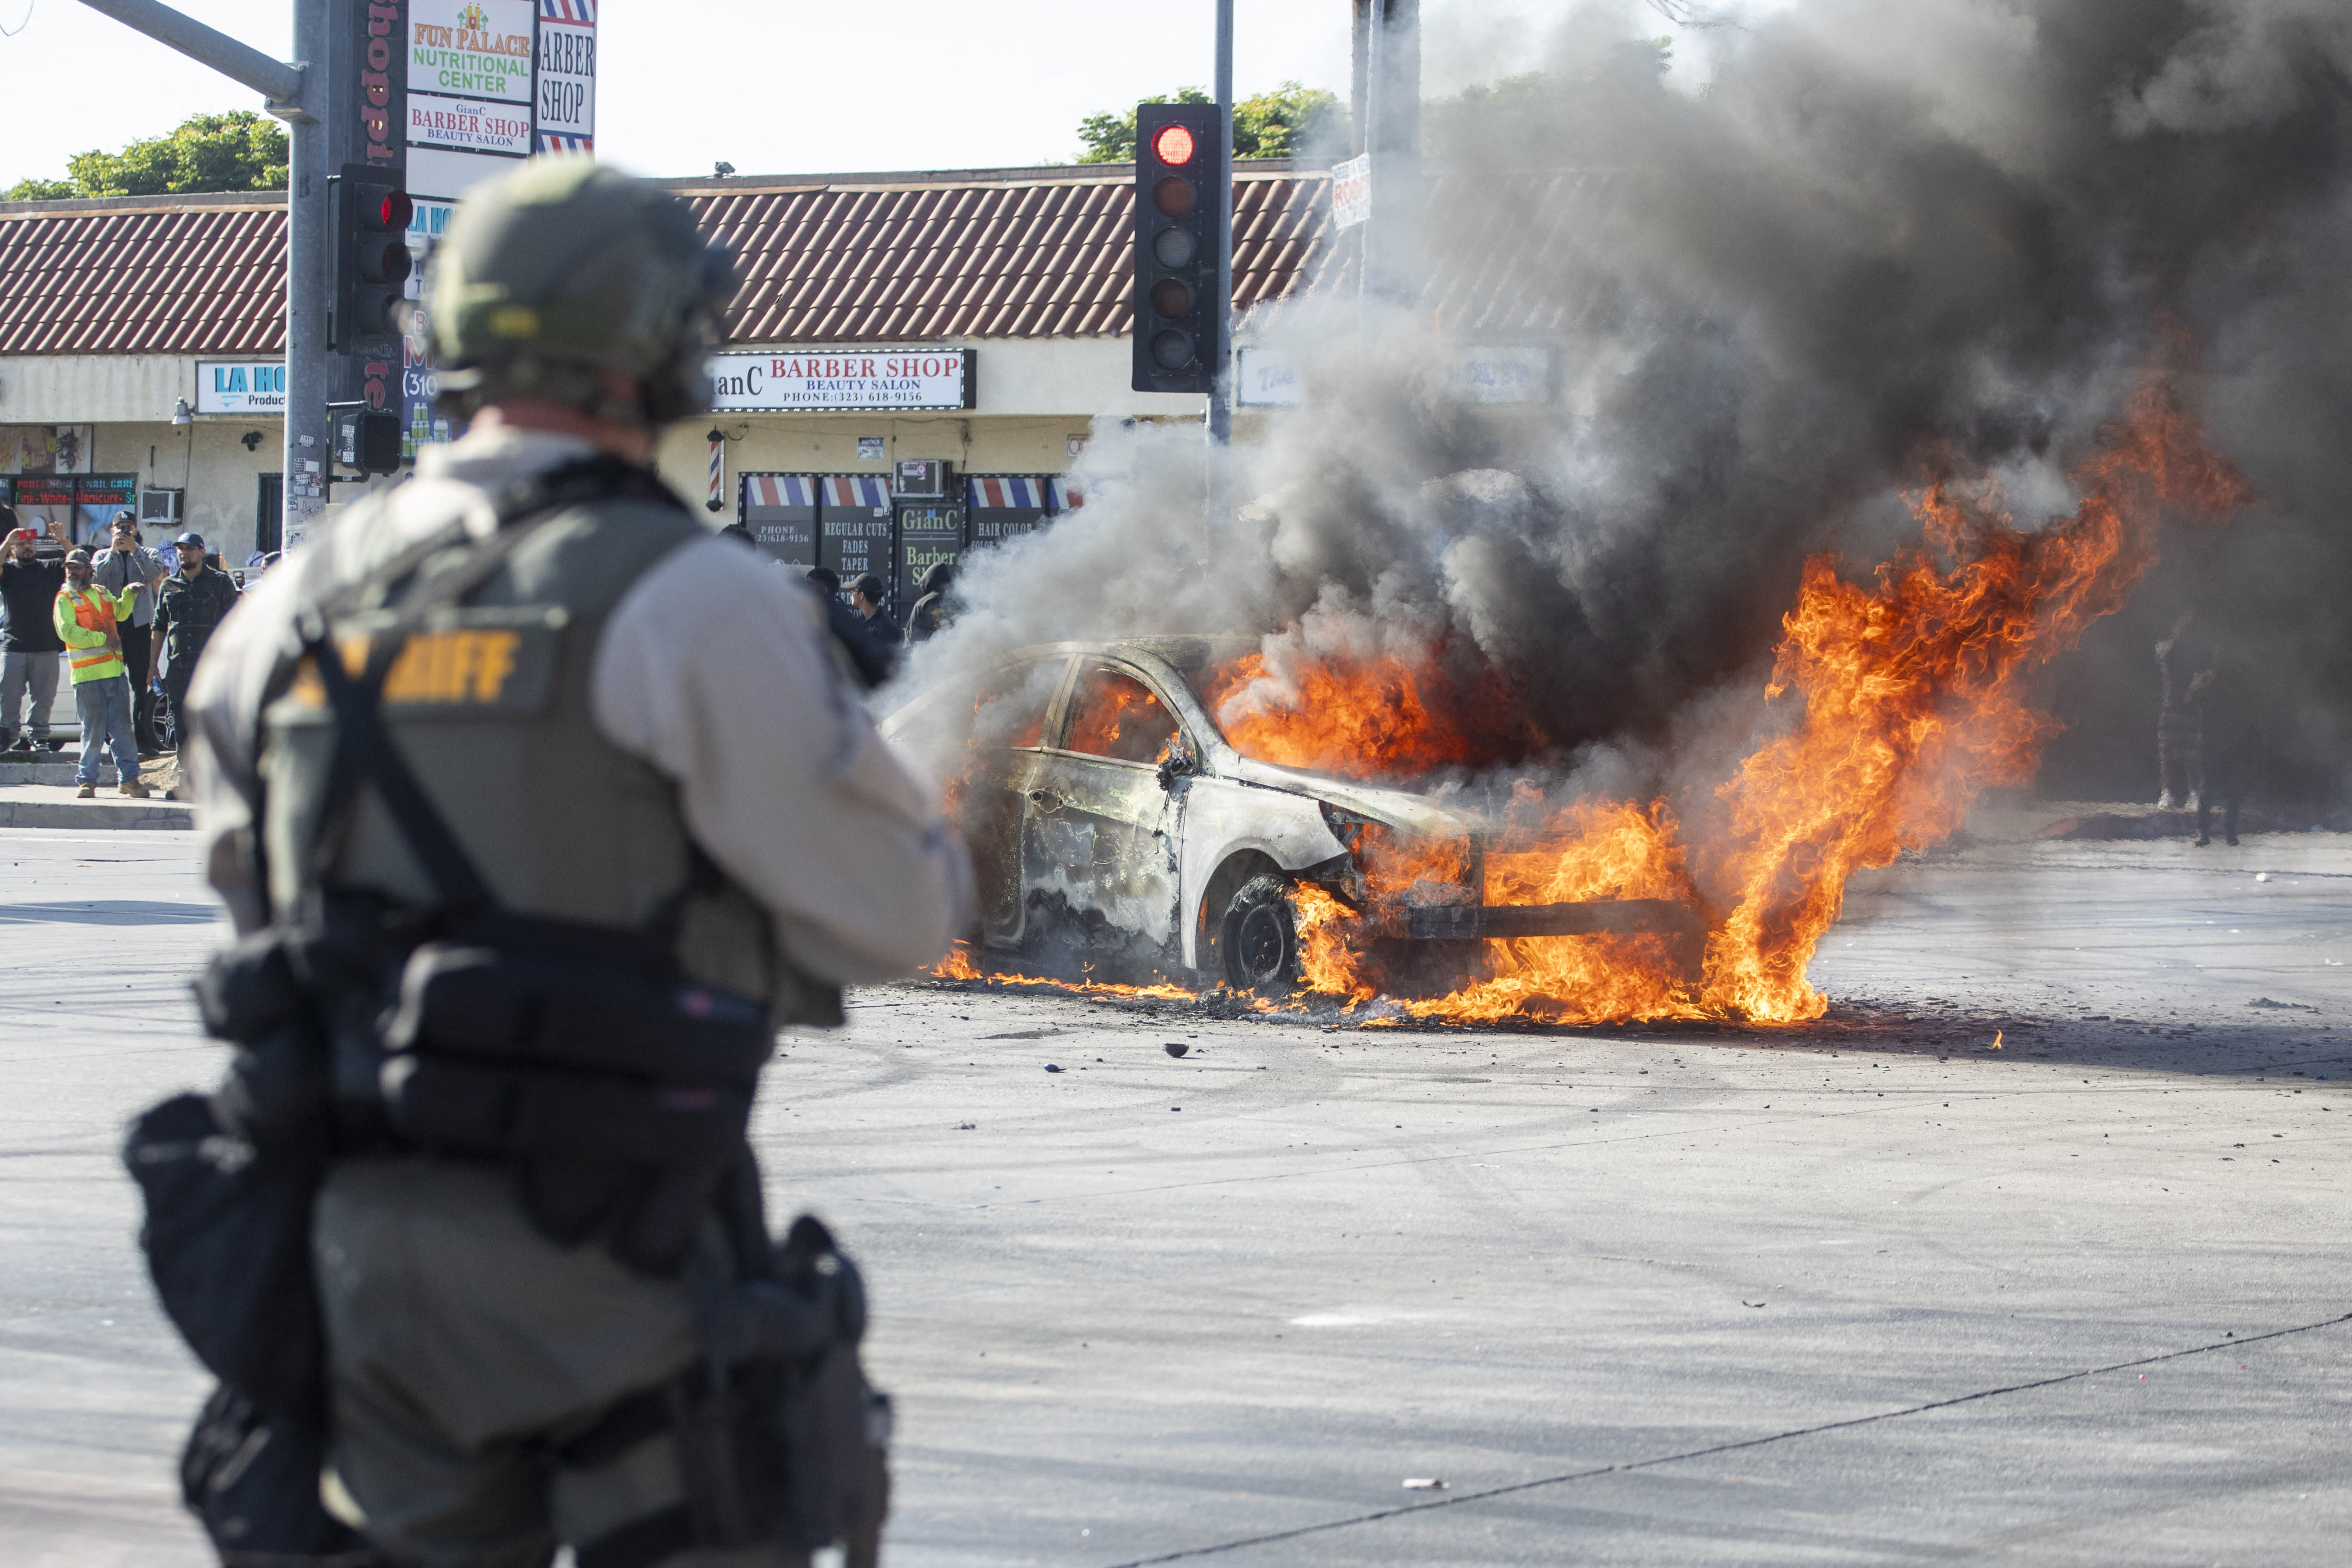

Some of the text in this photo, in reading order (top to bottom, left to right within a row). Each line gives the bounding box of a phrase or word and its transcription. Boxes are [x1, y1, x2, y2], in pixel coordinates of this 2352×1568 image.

[414, 23, 530, 58] FUN PALACE
[414, 47, 529, 77] NUTRITIONAL
[361, 0, 398, 167] hoppi
[439, 69, 506, 93] CENTER
[456, 104, 486, 116] GianC
[542, 78, 583, 123] SHOP
[412, 109, 529, 138] BARBER SHOP
[427, 128, 514, 146] BEAUTY SALON
[770, 358, 958, 378] BARBER SHOP
[215, 367, 248, 392] LA
[711, 366, 763, 396] anC
[806, 379, 921, 390] BEAUTY SALON
[249, 394, 285, 405] Produc
[869, 392, 922, 402] 618-9156
[87, 479, 107, 488] NAIL
[110, 479, 134, 488] CARE
[825, 522, 887, 536] REGULAR CUTS
[903, 509, 957, 530] GianC
[978, 522, 1000, 536] HAIR
[843, 540, 868, 553] FADES
[906, 546, 956, 565] Barber
[841, 557, 868, 570] TAPER
